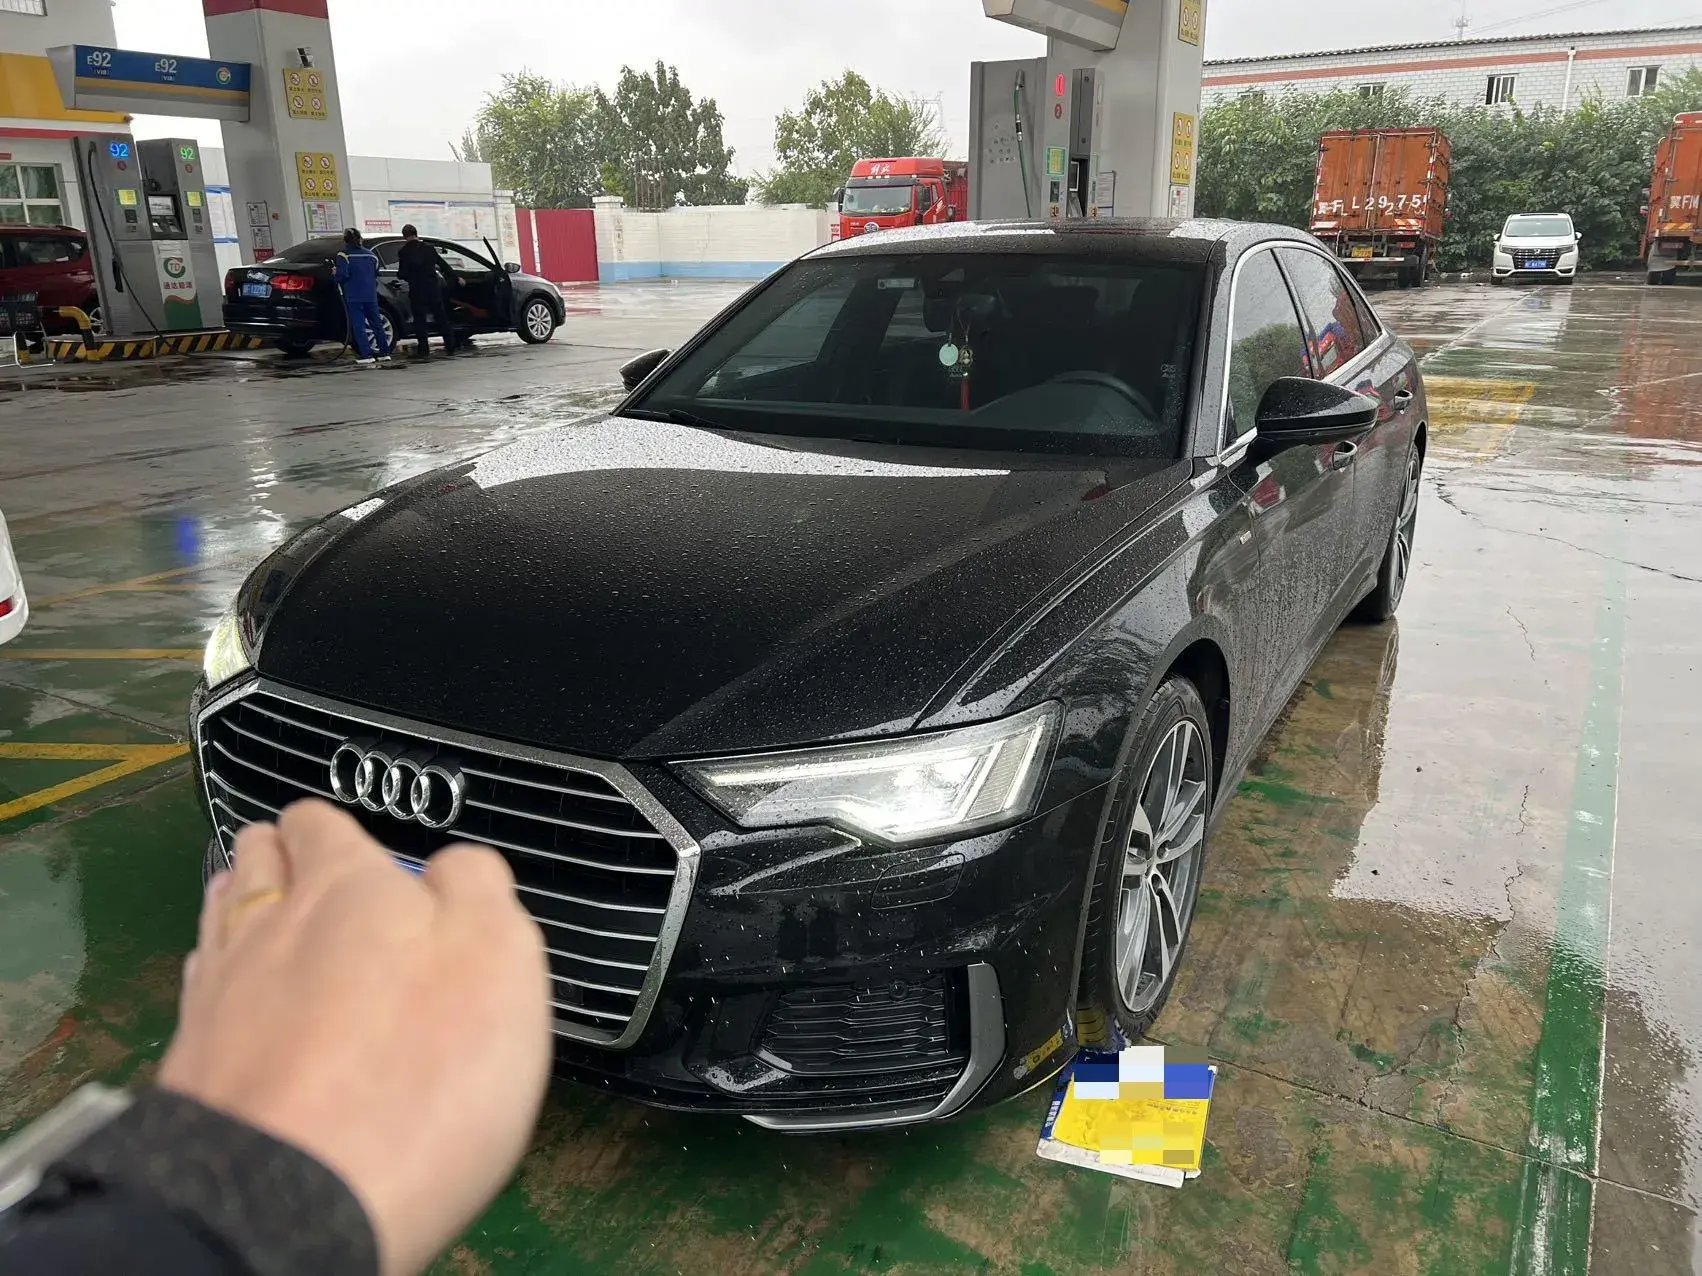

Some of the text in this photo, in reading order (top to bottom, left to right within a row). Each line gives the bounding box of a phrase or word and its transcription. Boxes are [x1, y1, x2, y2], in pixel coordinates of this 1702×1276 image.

[87, 51, 112, 67] E92
[154, 58, 178, 74] E92
[110, 143, 129, 157] 92
[180, 147, 195, 160] 92
[170, 262, 181, 272] TD
